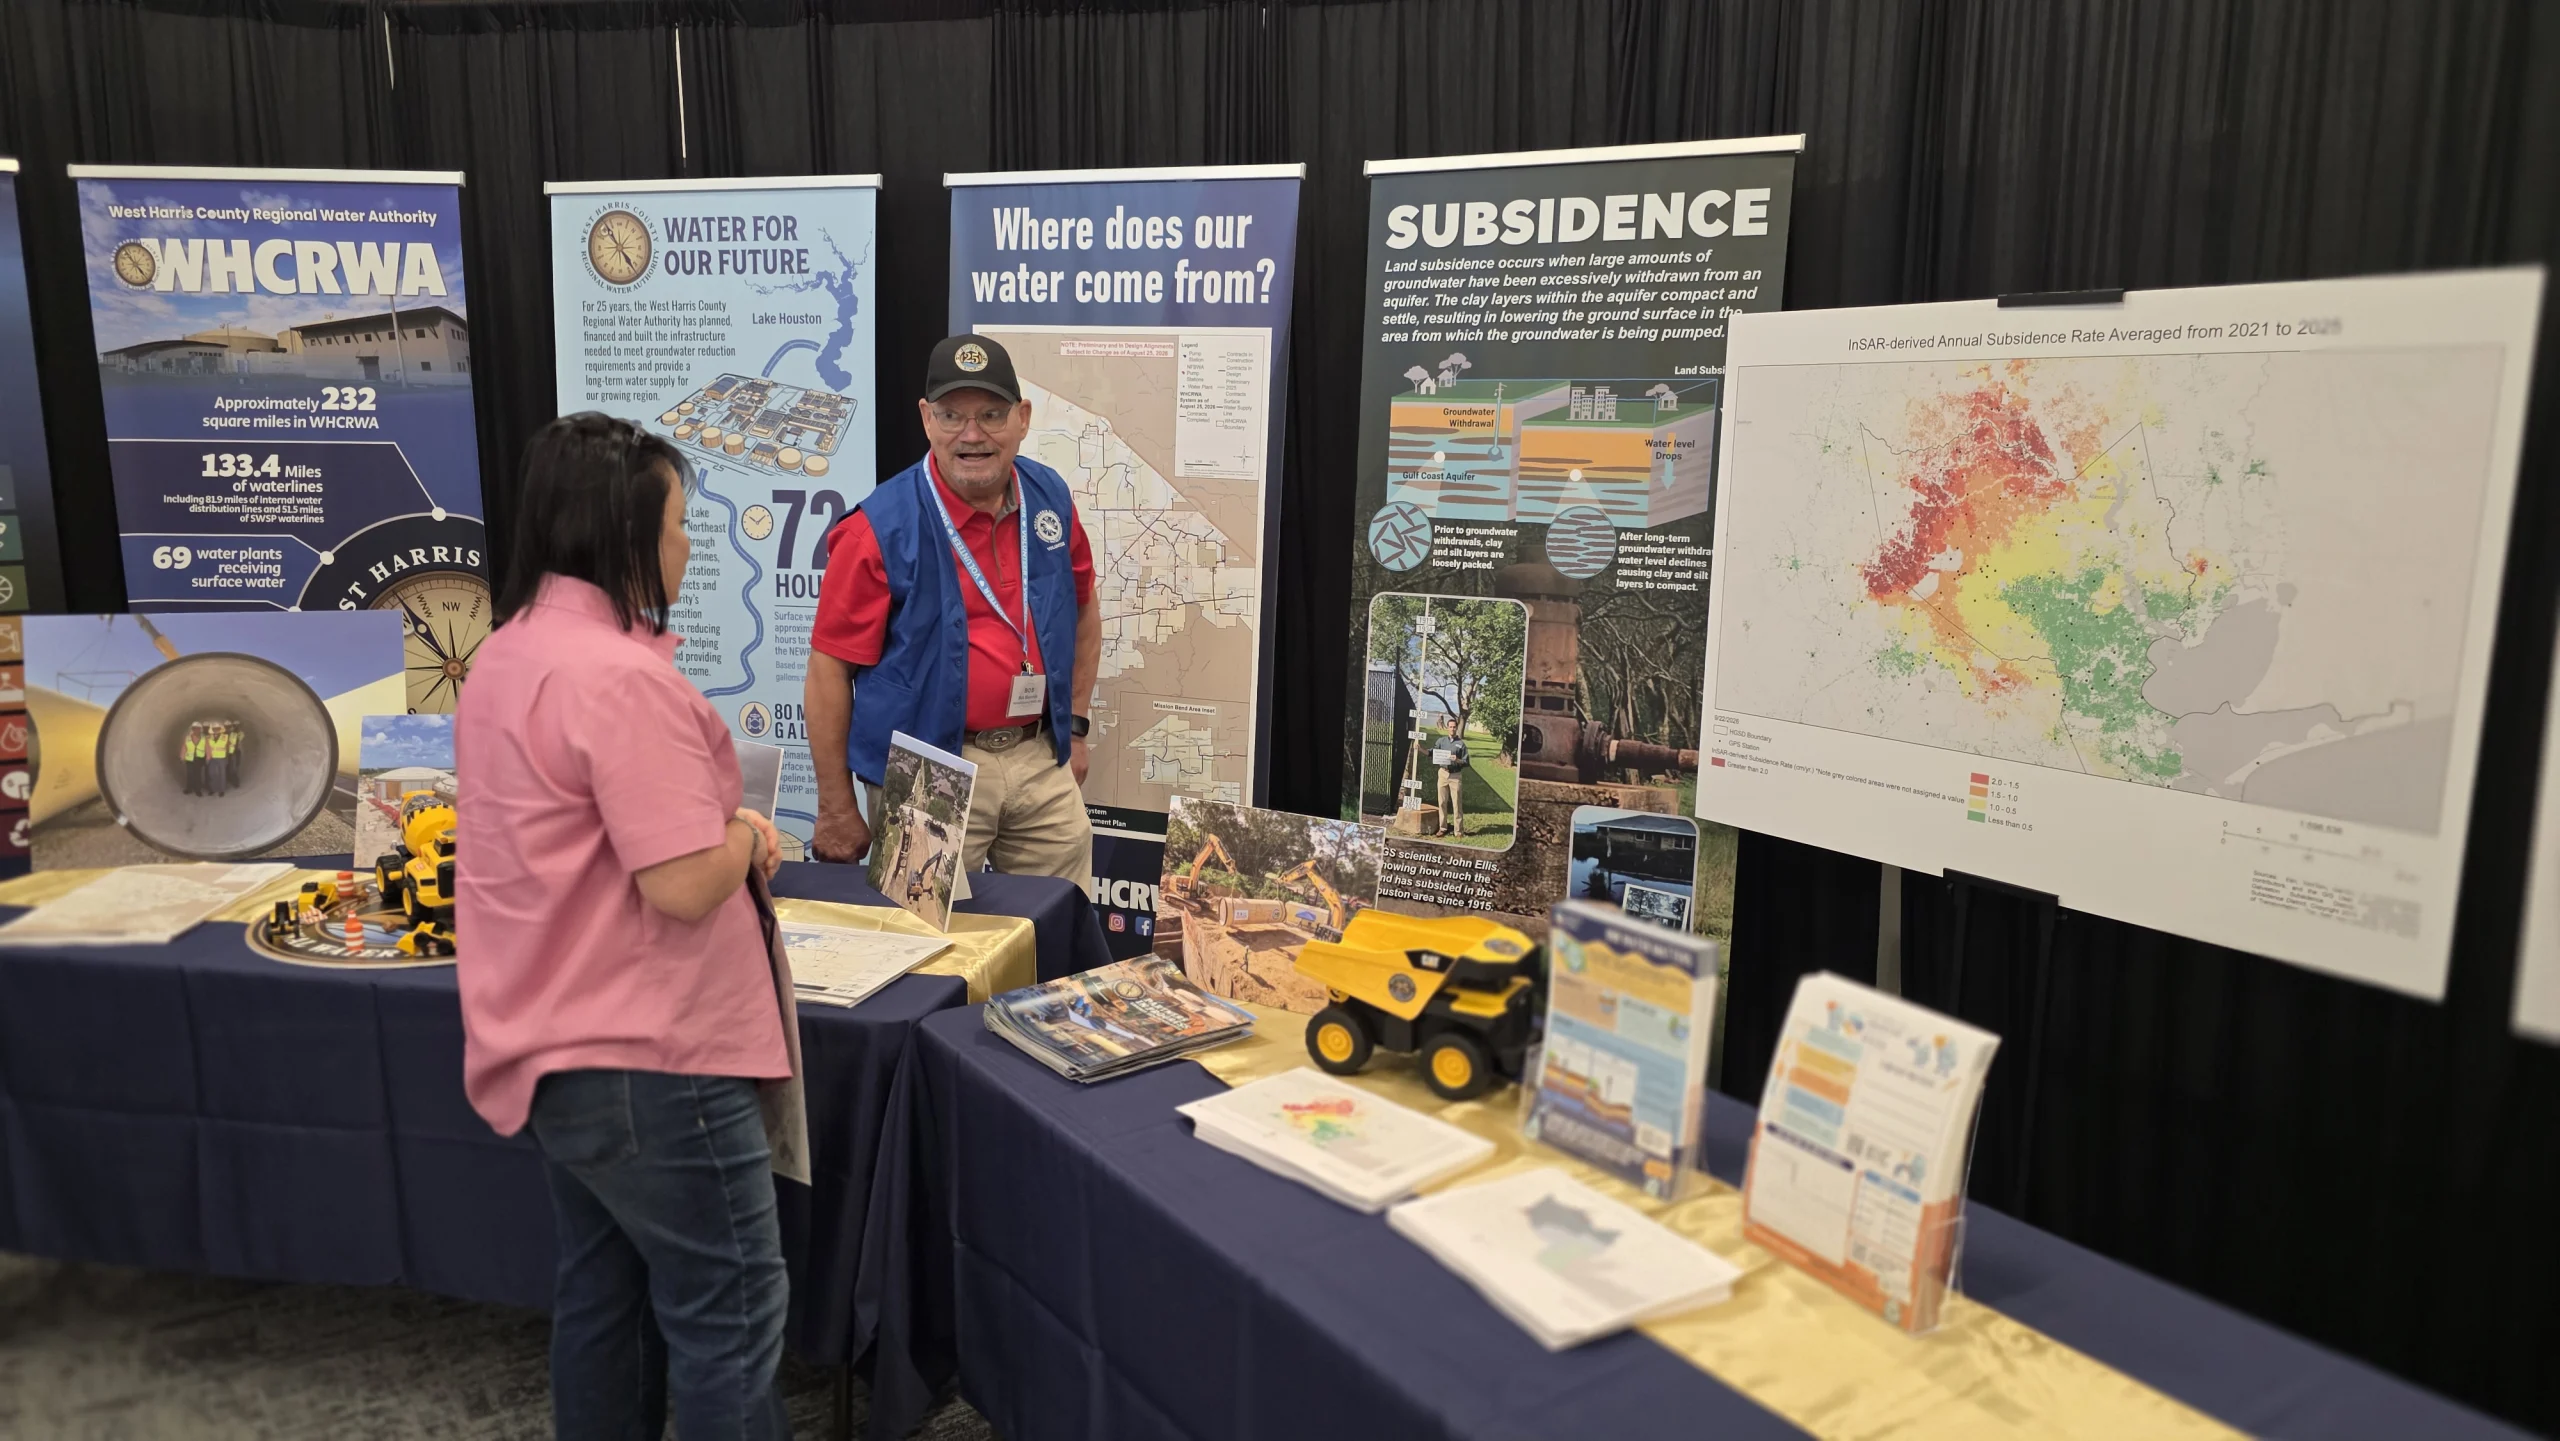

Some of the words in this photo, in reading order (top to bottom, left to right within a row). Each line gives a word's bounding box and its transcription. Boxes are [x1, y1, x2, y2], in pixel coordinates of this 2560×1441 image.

[108, 205, 146, 218] West
[148, 205, 193, 221] Harris
[196, 207, 250, 223] County
[252, 205, 317, 224] Regional
[319, 209, 365, 221] Water
[368, 209, 437, 227] Authority
[1385, 188, 1771, 249] SUBSIDENCE
[663, 216, 747, 242] WATER
[752, 215, 798, 241] FOR
[993, 207, 1093, 250] Where
[1106, 205, 1183, 249] does
[1195, 215, 1252, 249] our
[141, 238, 447, 296] WHCRWA
[664, 250, 713, 275] OUR
[718, 248, 810, 275] FUTURE
[1384, 259, 1417, 272] Land
[1419, 258, 1495, 271] subsidence
[1498, 258, 1545, 268] occurs
[1549, 254, 1585, 267] when
[1589, 253, 1624, 268] large
[1628, 251, 1692, 264] amounts
[1696, 249, 1713, 262] of
[971, 263, 1064, 302] water
[1075, 270, 1163, 303] come
[1174, 258, 1275, 303] from?
[1383, 276, 1466, 292] groundwater
[1468, 275, 1500, 287] have
[1503, 274, 1536, 286] been
[1540, 271, 1622, 287] excessively
[1625, 269, 1700, 283] withdrawn
[1703, 268, 1738, 281] from
[1742, 270, 1761, 280] an
[1383, 294, 1429, 310] aquifer.
[1435, 293, 1458, 306] The
[1461, 293, 1489, 308] clay
[1491, 292, 1532, 307] layers
[1536, 290, 1577, 304] within
[1581, 290, 1603, 303] the
[1607, 288, 1658, 305] aquifer
[1661, 287, 1725, 303] compact
[1728, 286, 1758, 299] and
[582, 300, 594, 312] For
[596, 300, 606, 312] 25
[609, 303, 632, 313] years,
[634, 300, 646, 311] the
[649, 300, 669, 311] West
[671, 300, 696, 311] Harris
[698, 300, 726, 312] County
[583, 315, 615, 329] Regional
[618, 315, 642, 326] Water
[644, 315, 680, 328] Authority
[683, 315, 696, 326] has
[699, 315, 732, 328] planned,
[752, 312, 776, 324] Lake
[779, 312, 821, 324] Houston
[1848, 335, 1934, 350] InSAR-derived
[1937, 333, 1982, 347] Annual
[1986, 331, 2066, 345] Subsidence
[2071, 329, 2105, 343] Rate
[2108, 325, 2182, 343] Averaged
[2187, 324, 2222, 338] from
[2228, 322, 2268, 337] 2021
[2276, 322, 2291, 336] to
[584, 345, 611, 356] needed
[613, 346, 621, 356] to
[624, 346, 643, 356] meet
[645, 345, 695, 358] groundwater
[698, 345, 735, 356] reduction
[964, 351, 978, 363] 25
[214, 396, 320, 413] Approximately
[321, 386, 376, 411] 232
[1443, 407, 1495, 415] Groundwater
[202, 416, 251, 430] square
[254, 414, 291, 428] miles
[293, 415, 307, 428] in
[309, 416, 379, 429] WHCRWA
[1449, 419, 1494, 427] Withdrawal
[1645, 439, 1671, 447] Water
[1674, 439, 1695, 448] level
[1655, 451, 1682, 462] Drops
[202, 453, 280, 478] 133.4
[285, 465, 321, 479] Miles
[1401, 470, 1419, 479] Gulf
[1421, 471, 1444, 480] Coast
[1445, 471, 1477, 482] Aquifer
[232, 479, 247, 491] of
[249, 479, 323, 492] waterlines
[163, 494, 204, 505] Including
[224, 495, 248, 503] miles
[249, 495, 259, 503] of
[296, 496, 322, 504] water
[189, 504, 240, 513] distribution
[241, 505, 262, 513] lines
[263, 505, 281, 513] and
[299, 505, 323, 513] miles
[239, 514, 249, 522] of
[250, 514, 277, 522] SWSP
[278, 514, 324, 523] waterlines
[687, 522, 726, 532] Northeast
[772, 489, 846, 570] 72
[1434, 525, 1454, 533] Prior
[1456, 526, 1464, 534] to
[1465, 527, 1518, 536] groundwater
[1433, 537, 1483, 548] withdrawals,
[1485, 538, 1503, 548] clay
[153, 546, 192, 569] 69
[197, 550, 237, 559] water
[240, 547, 282, 562] plants
[950, 536, 980, 580] VOLUNTEER
[1432, 548, 1448, 556] and
[1449, 548, 1462, 556] silt
[1463, 549, 1488, 559] layers
[219, 563, 281, 577] receiving
[369, 546, 480, 583] HARRIS
[1432, 558, 1461, 569] loosely
[1462, 560, 1494, 570] packed.
[191, 575, 243, 587] surface
[244, 576, 286, 588] water
[442, 602, 461, 612] NW
[1991, 777, 2002, 786] 2.0
[2009, 781, 2019, 789] 1.5
[1988, 816, 2004, 825] Less
[2005, 820, 2020, 828] than
[2021, 823, 2032, 831] 0.5
[1398, 850, 1443, 865] scientist,
[1446, 856, 1472, 868] John
[1474, 859, 1499, 872] Ellis,
[1419, 865, 1441, 876] how
[1442, 870, 1471, 881] much
[1474, 873, 1490, 883] the
[1394, 875, 1412, 885] has
[1415, 879, 1463, 893] subsided
[1464, 885, 1474, 895] in
[1474, 887, 1493, 897] the
[1411, 892, 1434, 902] area
[1437, 895, 1464, 906] since
[1468, 899, 1493, 912] 1915.
